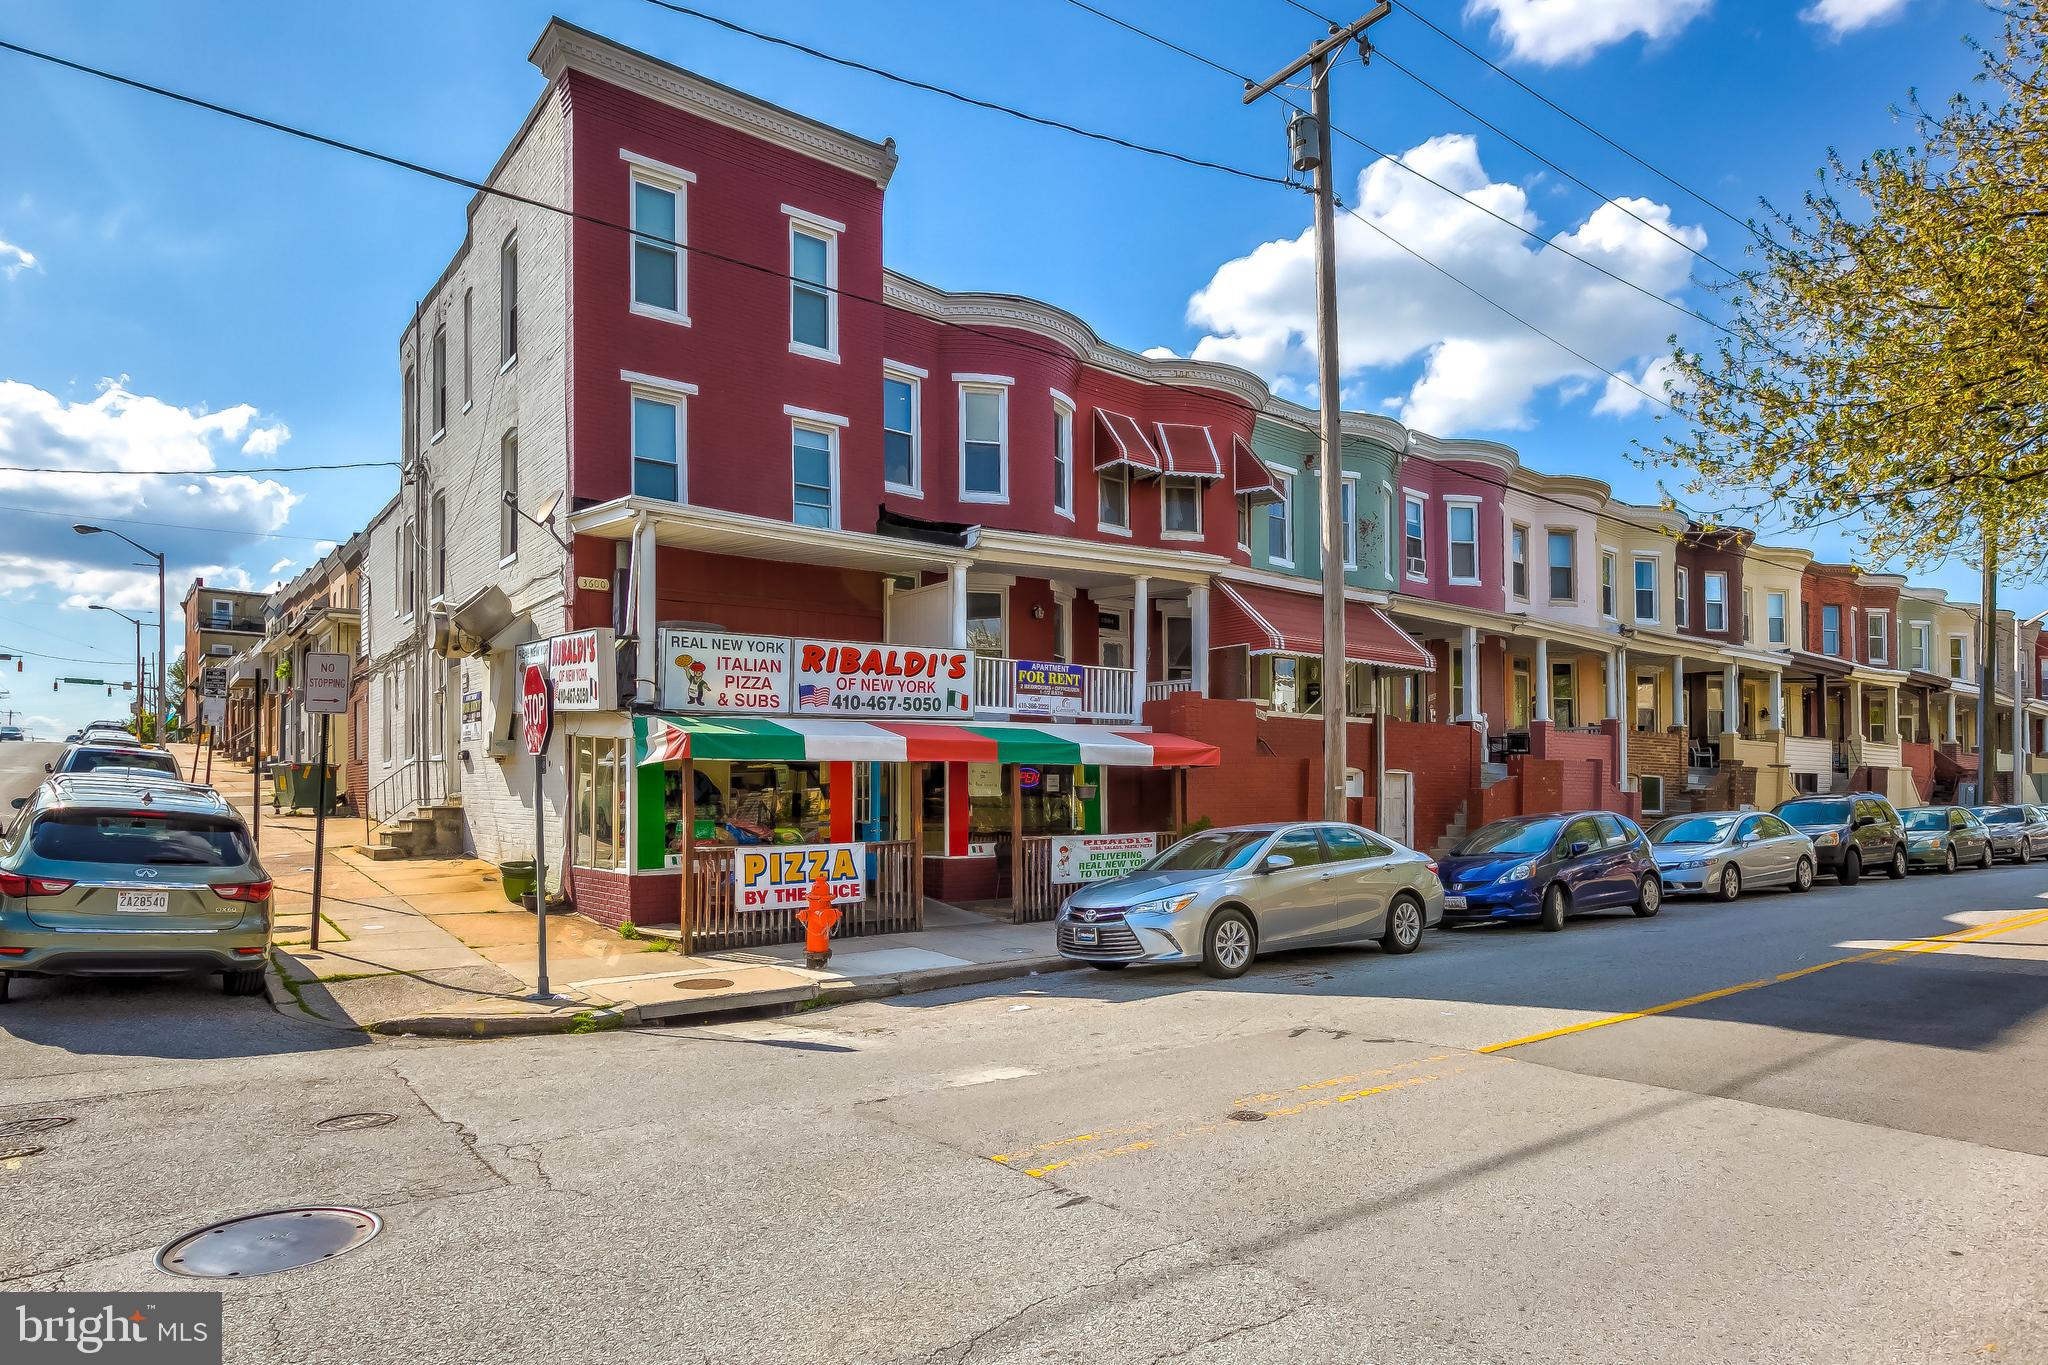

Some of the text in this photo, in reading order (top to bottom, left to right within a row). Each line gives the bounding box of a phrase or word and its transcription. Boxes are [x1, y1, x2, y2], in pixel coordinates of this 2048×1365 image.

[582, 578, 606, 589] 3600
[553, 634, 596, 666] RIBALDI'S
[671, 636, 785, 654] REAL NEW YORK
[320, 663, 335, 673] NO
[717, 656, 782, 674] ITALIAN
[802, 645, 967, 679] RIBALDI'S
[1031, 664, 1070, 672] APARTMENT
[566, 668, 575, 682] NEW
[576, 668, 588, 681] YORK
[725, 675, 773, 690] PIZZA
[1018, 670, 1081, 687] FOR RENT
[309, 678, 346, 689] STOPPING
[836, 677, 936, 694] OF NEW YORK
[717, 693, 780, 709] & SUBS
[832, 694, 942, 713] 410-467-5050
[524, 693, 544, 729] STOP
[1019, 771, 1041, 784] PEN
[1090, 851, 1142, 861] DELIVERING
[744, 849, 859, 887] PIZZA
[1079, 862, 1101, 870] REAL
[1130, 859, 1148, 867] YOR
[1095, 869, 1119, 877] YOUR
[744, 890, 768, 905] BY
[775, 888, 806, 903] THE
